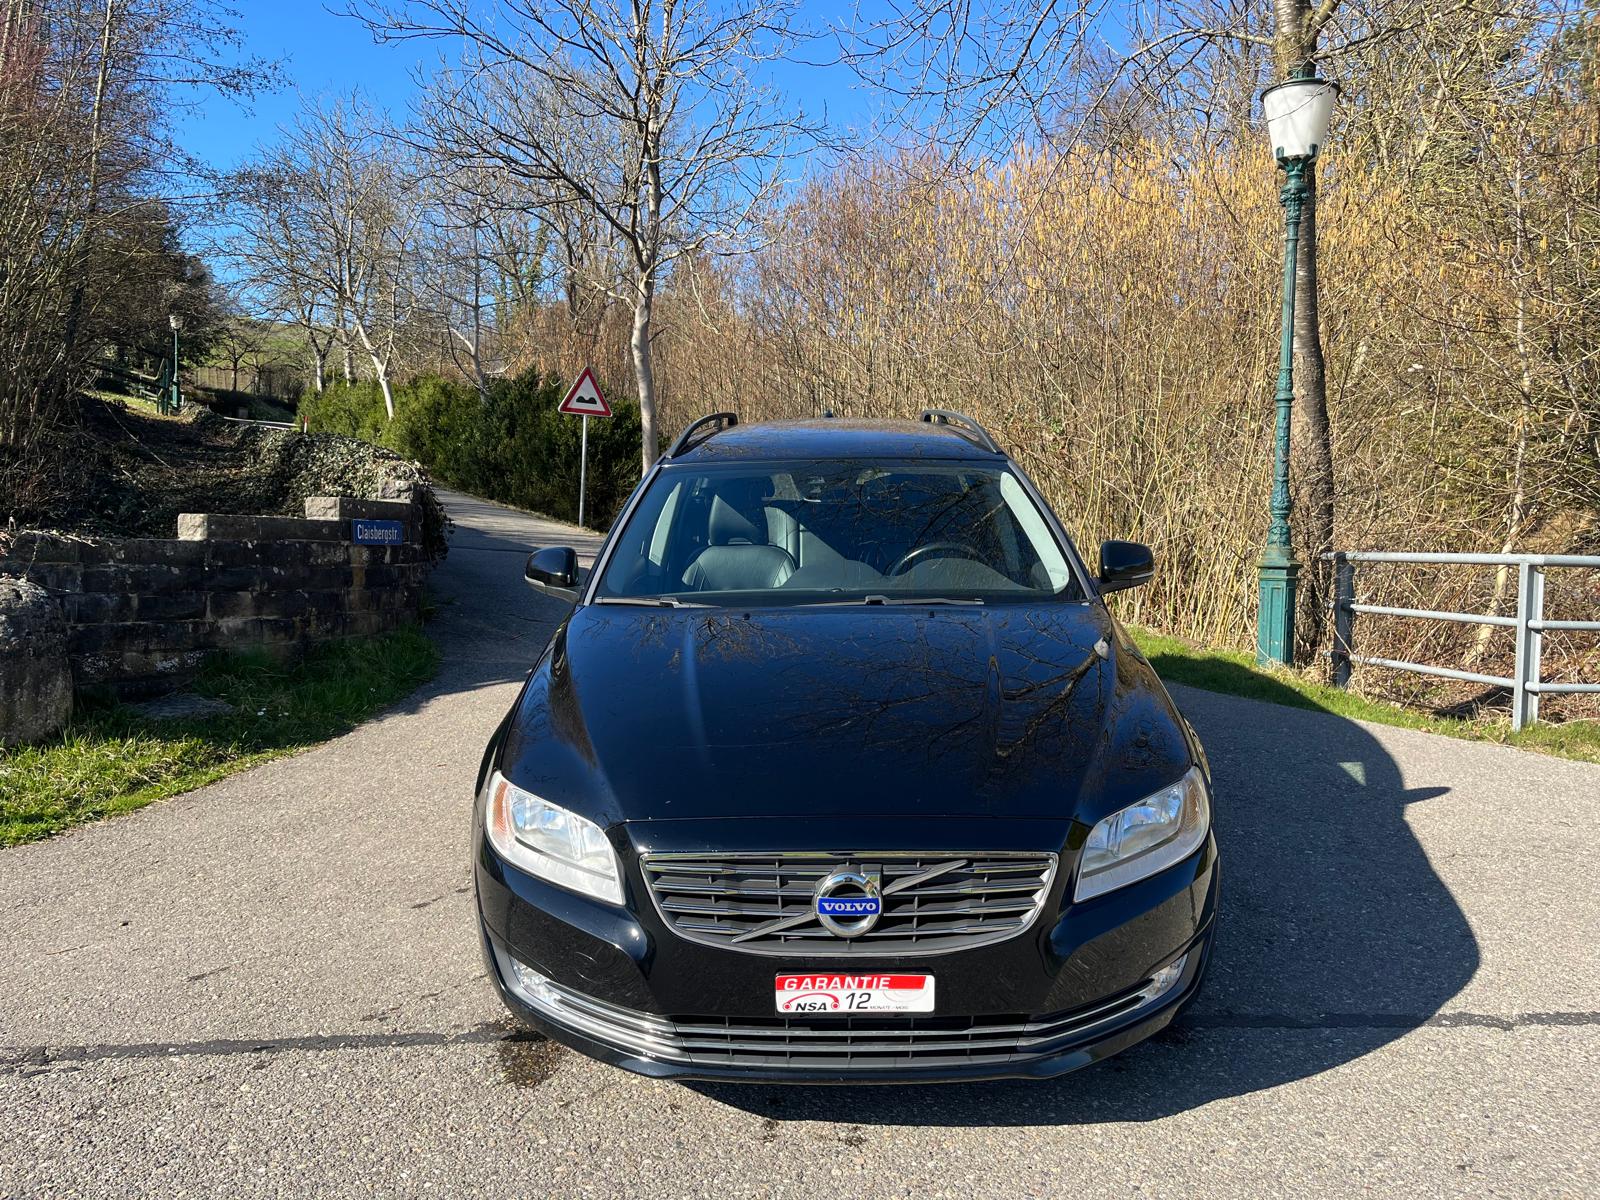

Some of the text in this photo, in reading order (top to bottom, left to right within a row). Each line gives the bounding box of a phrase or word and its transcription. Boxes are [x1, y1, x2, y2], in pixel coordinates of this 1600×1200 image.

[822, 902, 876, 911] VOLVO
[783, 975, 890, 990] GARANTIE
[795, 1002, 828, 1012] NSA
[845, 993, 872, 1009] 12
